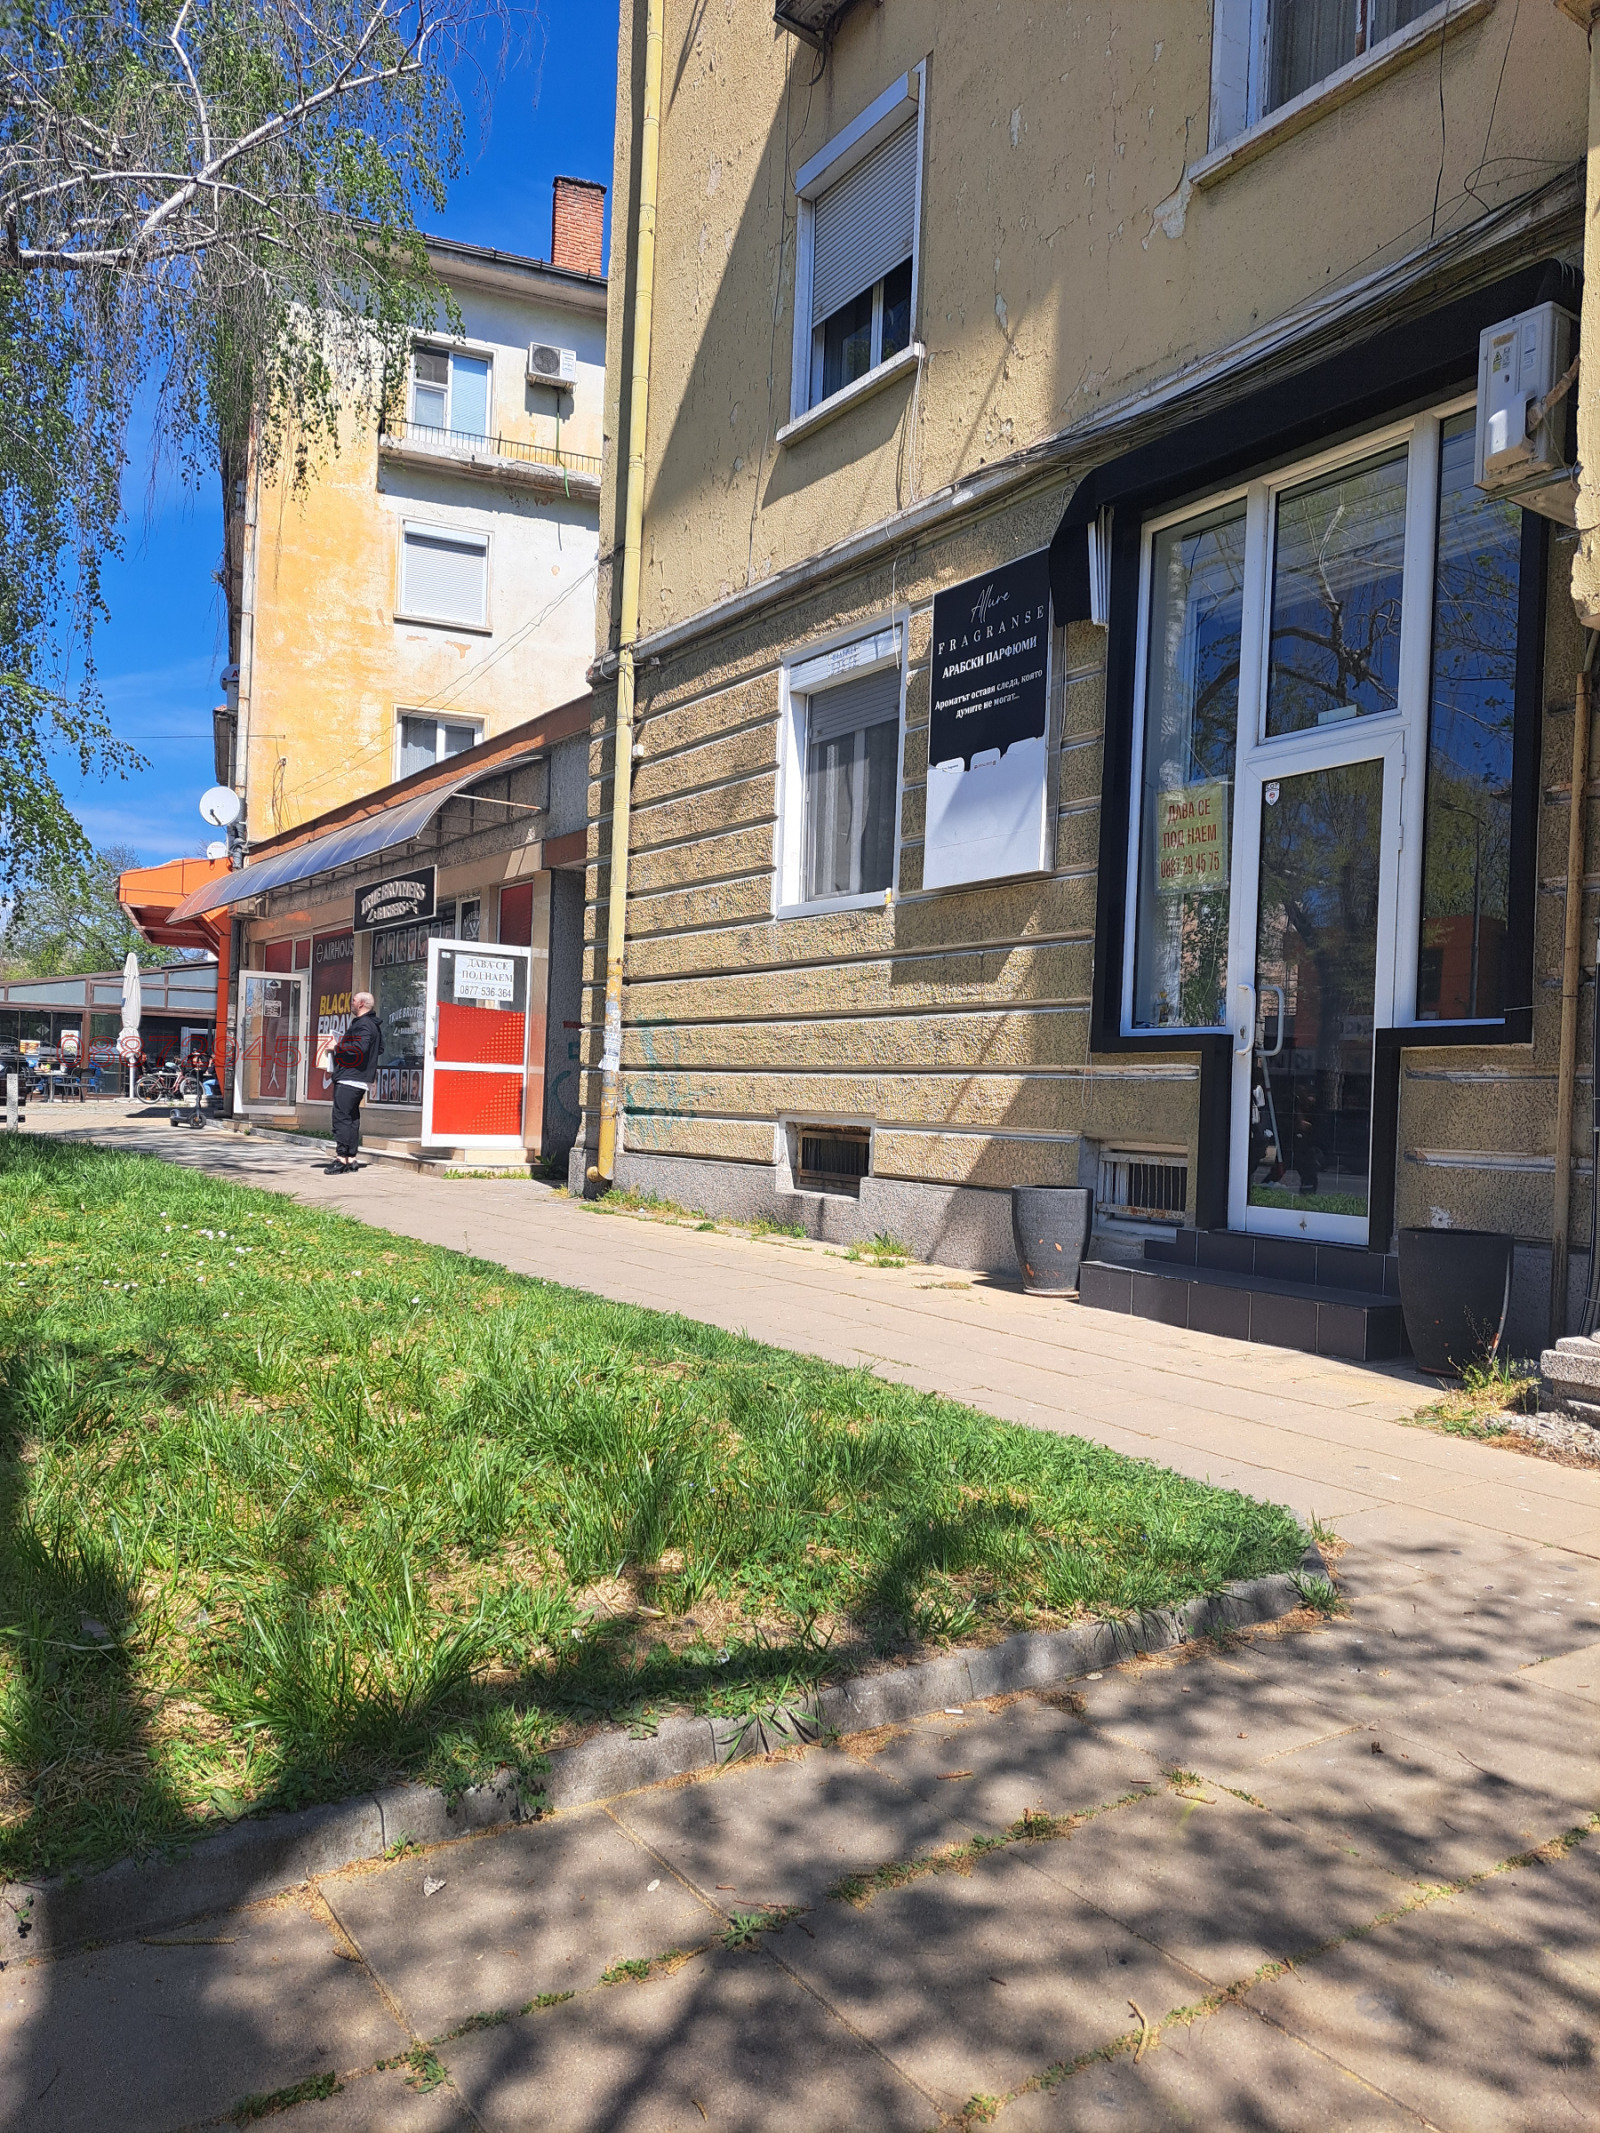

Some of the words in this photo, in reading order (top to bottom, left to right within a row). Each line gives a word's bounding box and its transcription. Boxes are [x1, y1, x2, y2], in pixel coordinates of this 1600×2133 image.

[937, 604, 1044, 655] FRAGRANSE
[942, 653, 984, 679] АРАБСКИ
[985, 635, 1038, 664] ПАРФЮМИ
[934, 692, 971, 712] Ароматът
[970, 684, 996, 699] оставя
[996, 676, 1020, 692] следа,
[1021, 668, 1043, 683] която
[955, 702, 983, 719] думите
[983, 700, 994, 710] не
[1167, 801, 1195, 825] ДАВА
[1197, 798, 1211, 816] СЕ
[1163, 829, 1185, 849] ПОД
[1187, 823, 1217, 844] НАЕМ
[1183, 854, 1193, 875] 29
[1208, 851, 1220, 872] 75
[361, 886, 382, 916] TRUE
[381, 880, 426, 901] BROTHERS
[462, 970, 483, 981] ПОД
[484, 973, 513, 983] НАЕМ
[467, 958, 493, 969] ДАВА
[495, 961, 509, 971] СЕ
[319, 991, 353, 1016] BLACK
[459, 985, 479, 995] 0877
[481, 987, 496, 997] 536
[497, 988, 512, 998] 364
